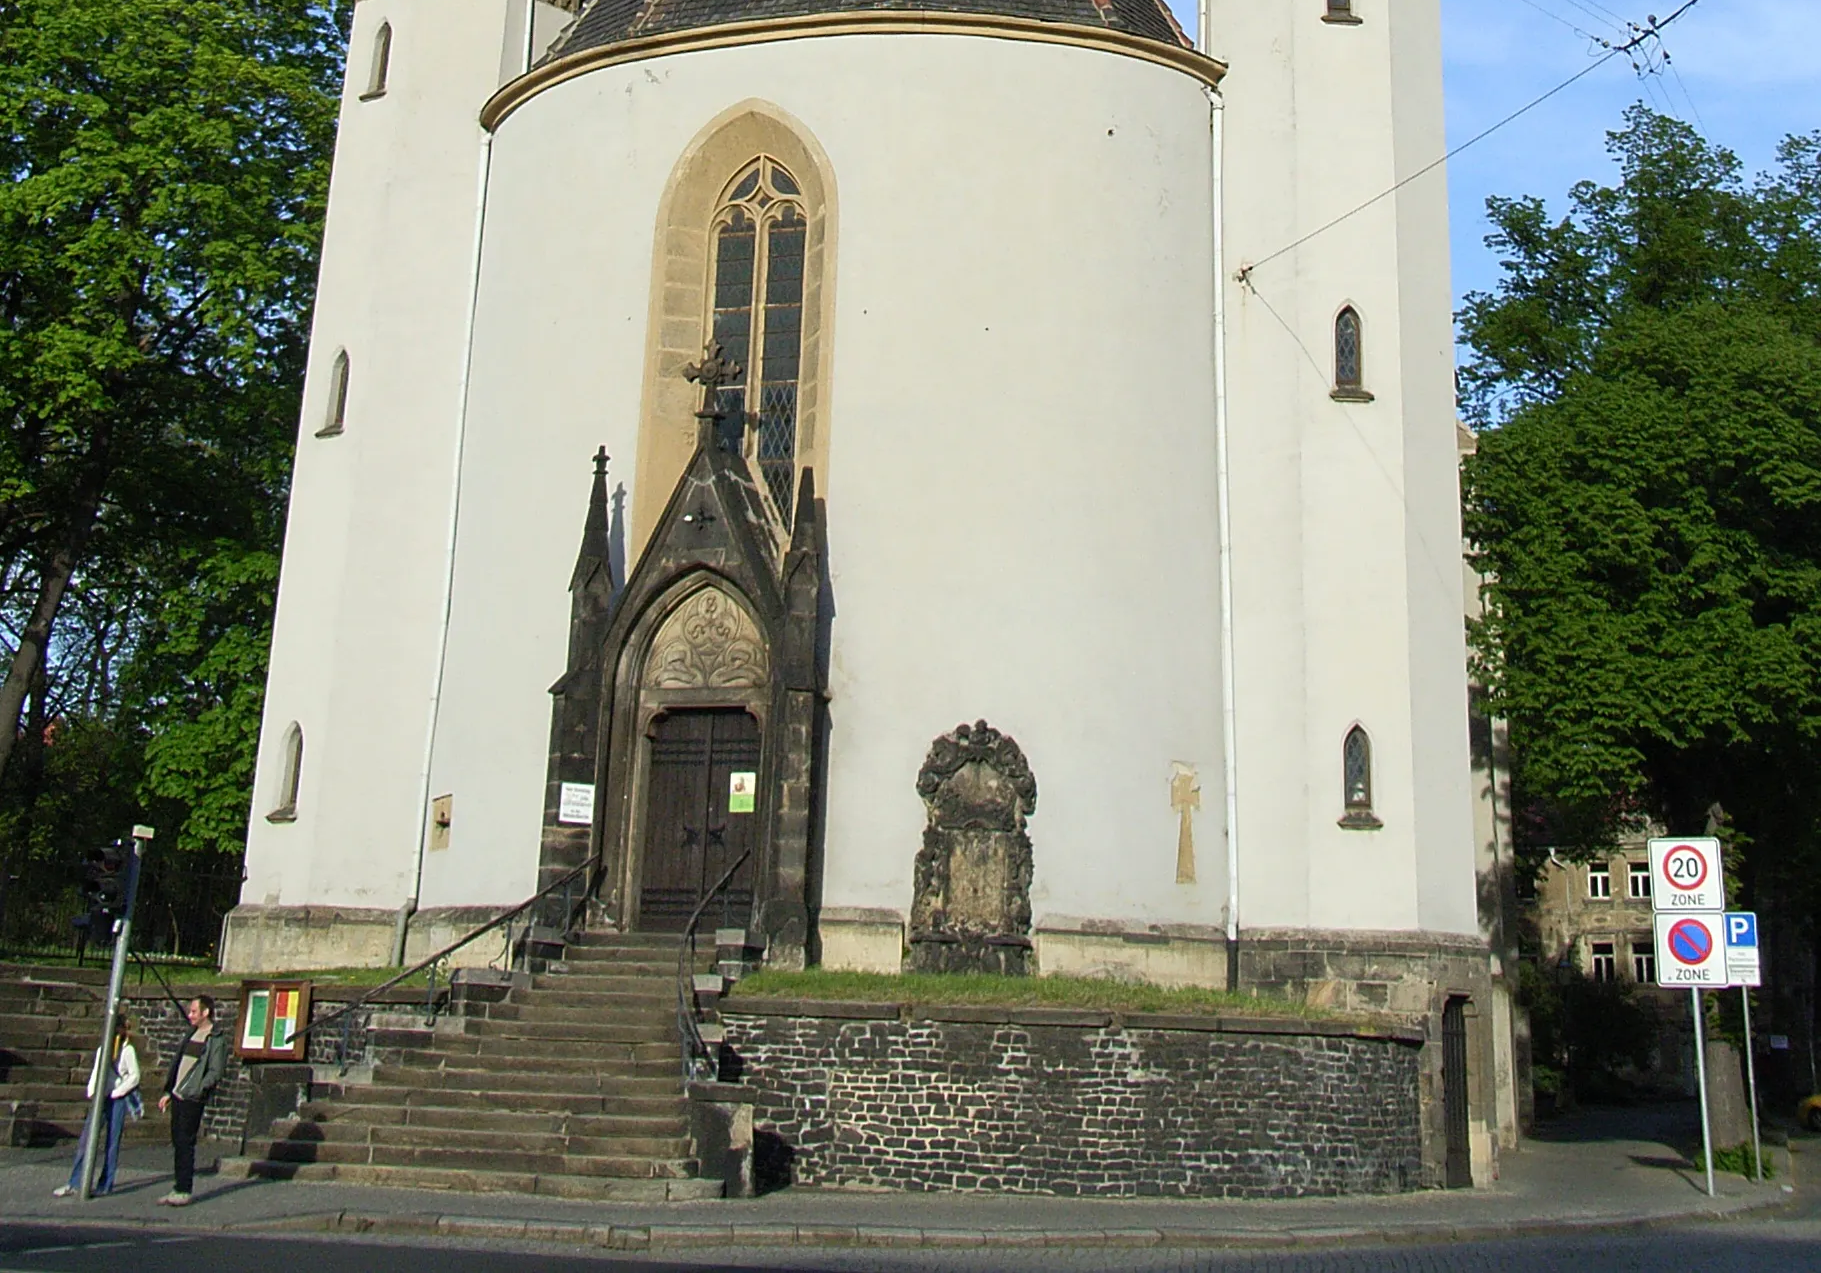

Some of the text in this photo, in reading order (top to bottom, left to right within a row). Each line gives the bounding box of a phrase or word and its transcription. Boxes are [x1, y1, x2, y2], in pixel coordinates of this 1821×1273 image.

[1672, 857, 1698, 878] 20
[1671, 893, 1706, 906] ZONE
[1730, 917, 1749, 943] P
[1675, 968, 1711, 981] ZONE
